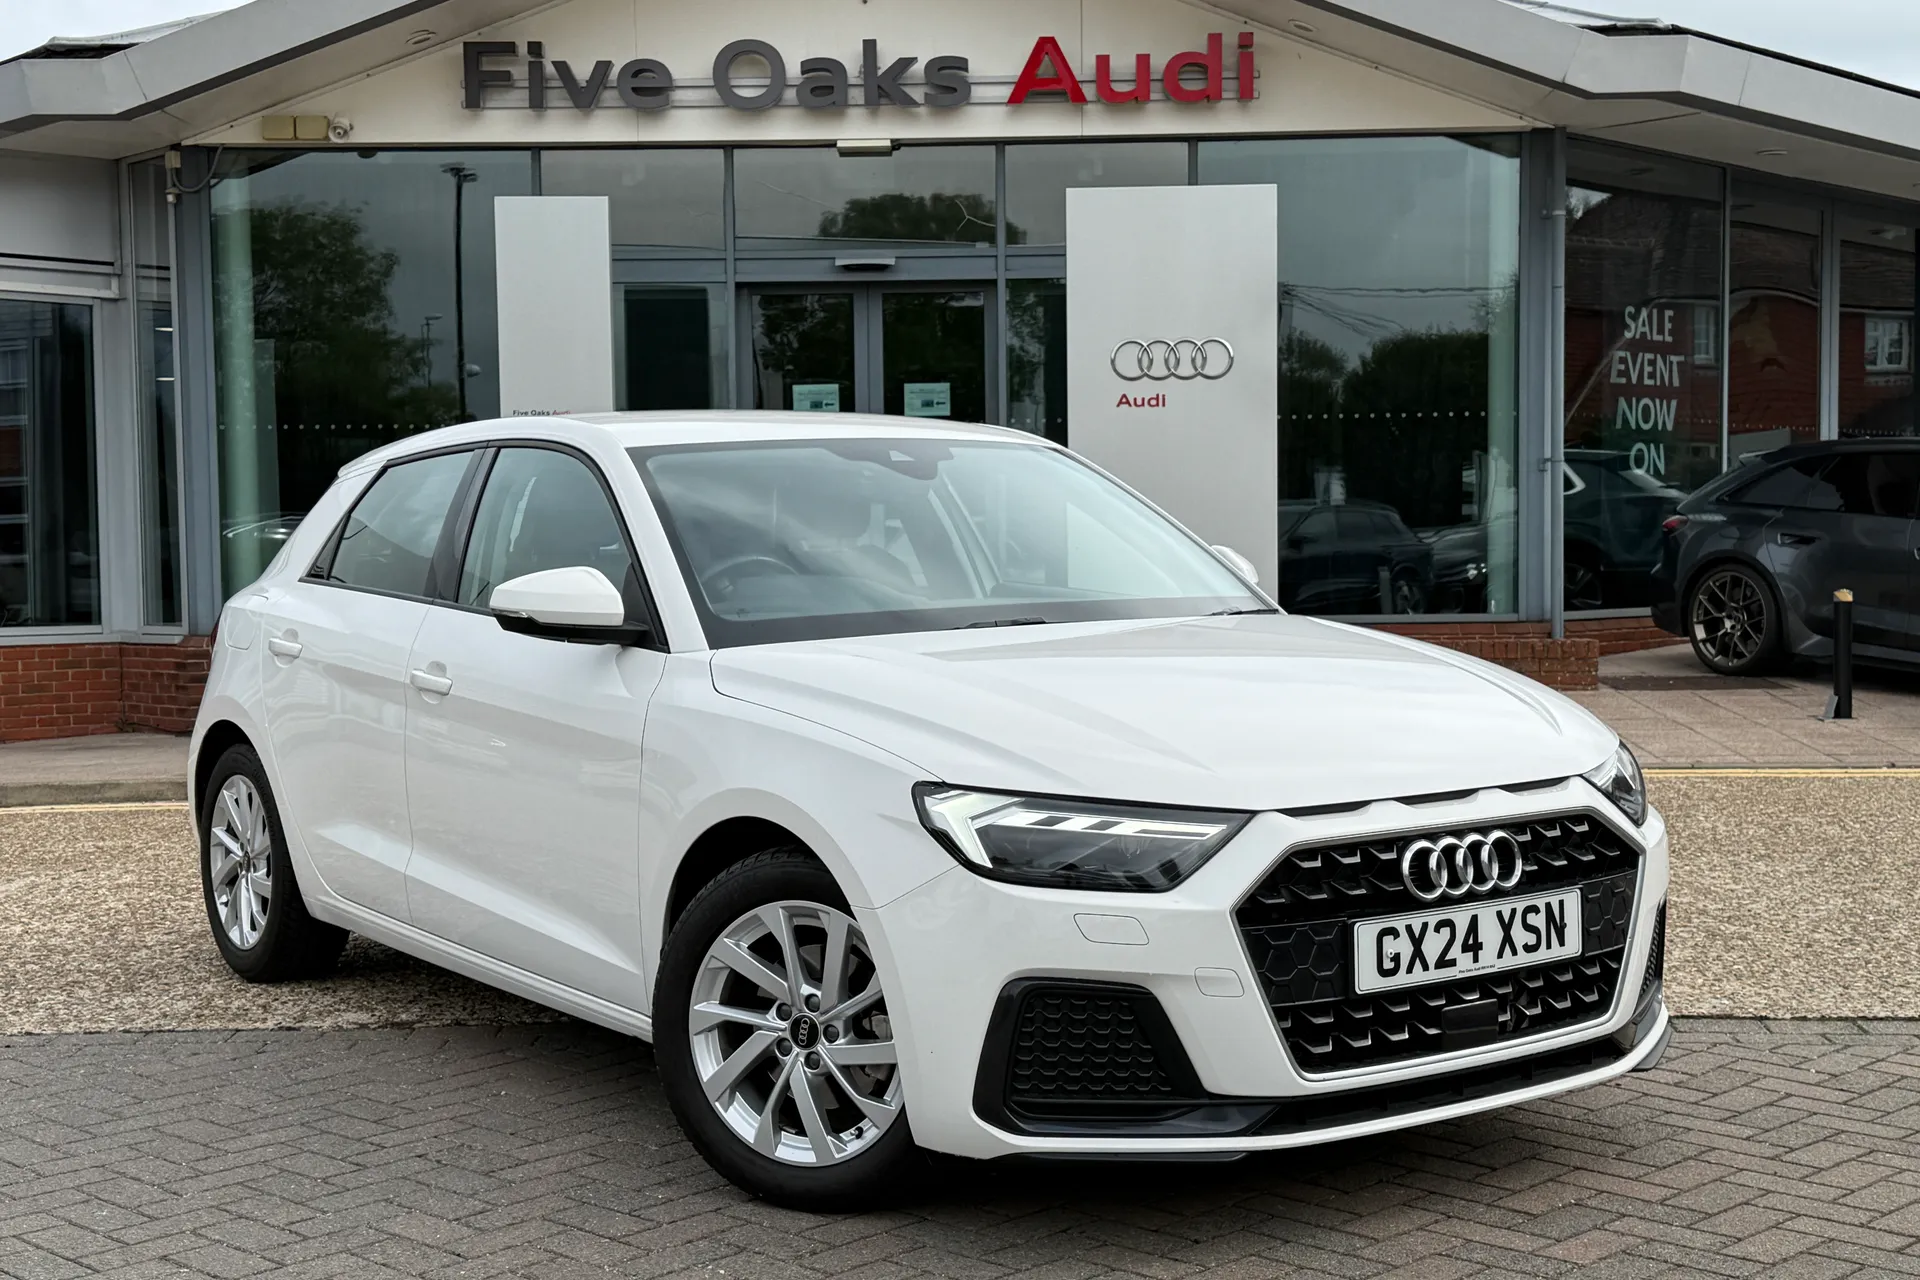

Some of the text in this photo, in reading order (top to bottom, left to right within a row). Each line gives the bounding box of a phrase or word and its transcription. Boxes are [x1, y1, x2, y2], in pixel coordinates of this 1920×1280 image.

[463, 32, 1254, 110] Five Oaks Audi
[1624, 305, 1674, 342] SALE
[1610, 351, 1684, 387] EVENT
[1116, 393, 1166, 408] Audi
[1615, 397, 1678, 431] NOW
[1629, 442, 1665, 476] ON
[1376, 899, 1566, 978] GX24 XSN
